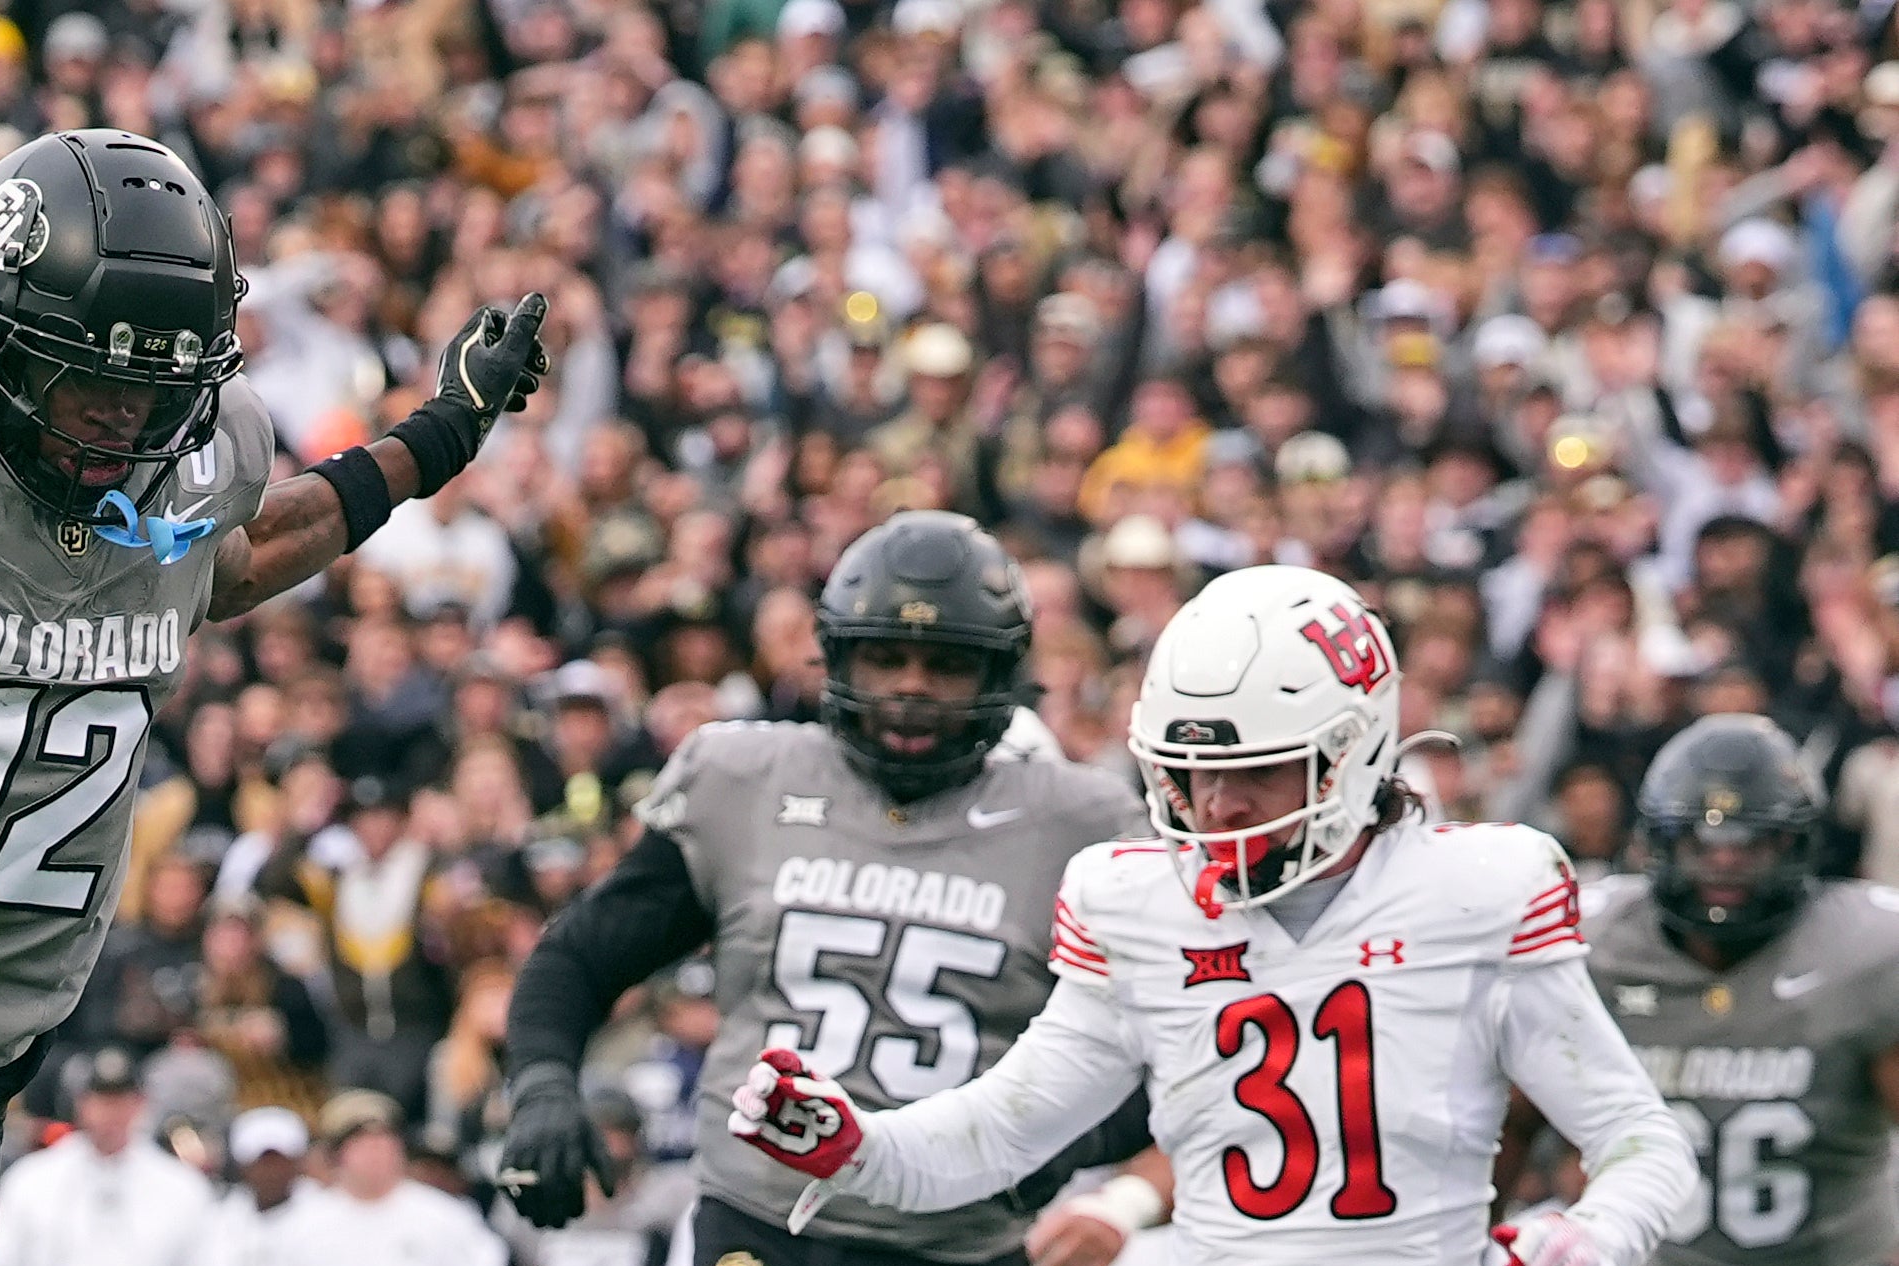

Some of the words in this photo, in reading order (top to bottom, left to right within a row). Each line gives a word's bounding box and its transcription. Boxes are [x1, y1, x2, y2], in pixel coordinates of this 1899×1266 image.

[773, 856, 1007, 931] COLORADO
[764, 908, 1007, 1100] 55
[1215, 980, 1397, 1220] 31
